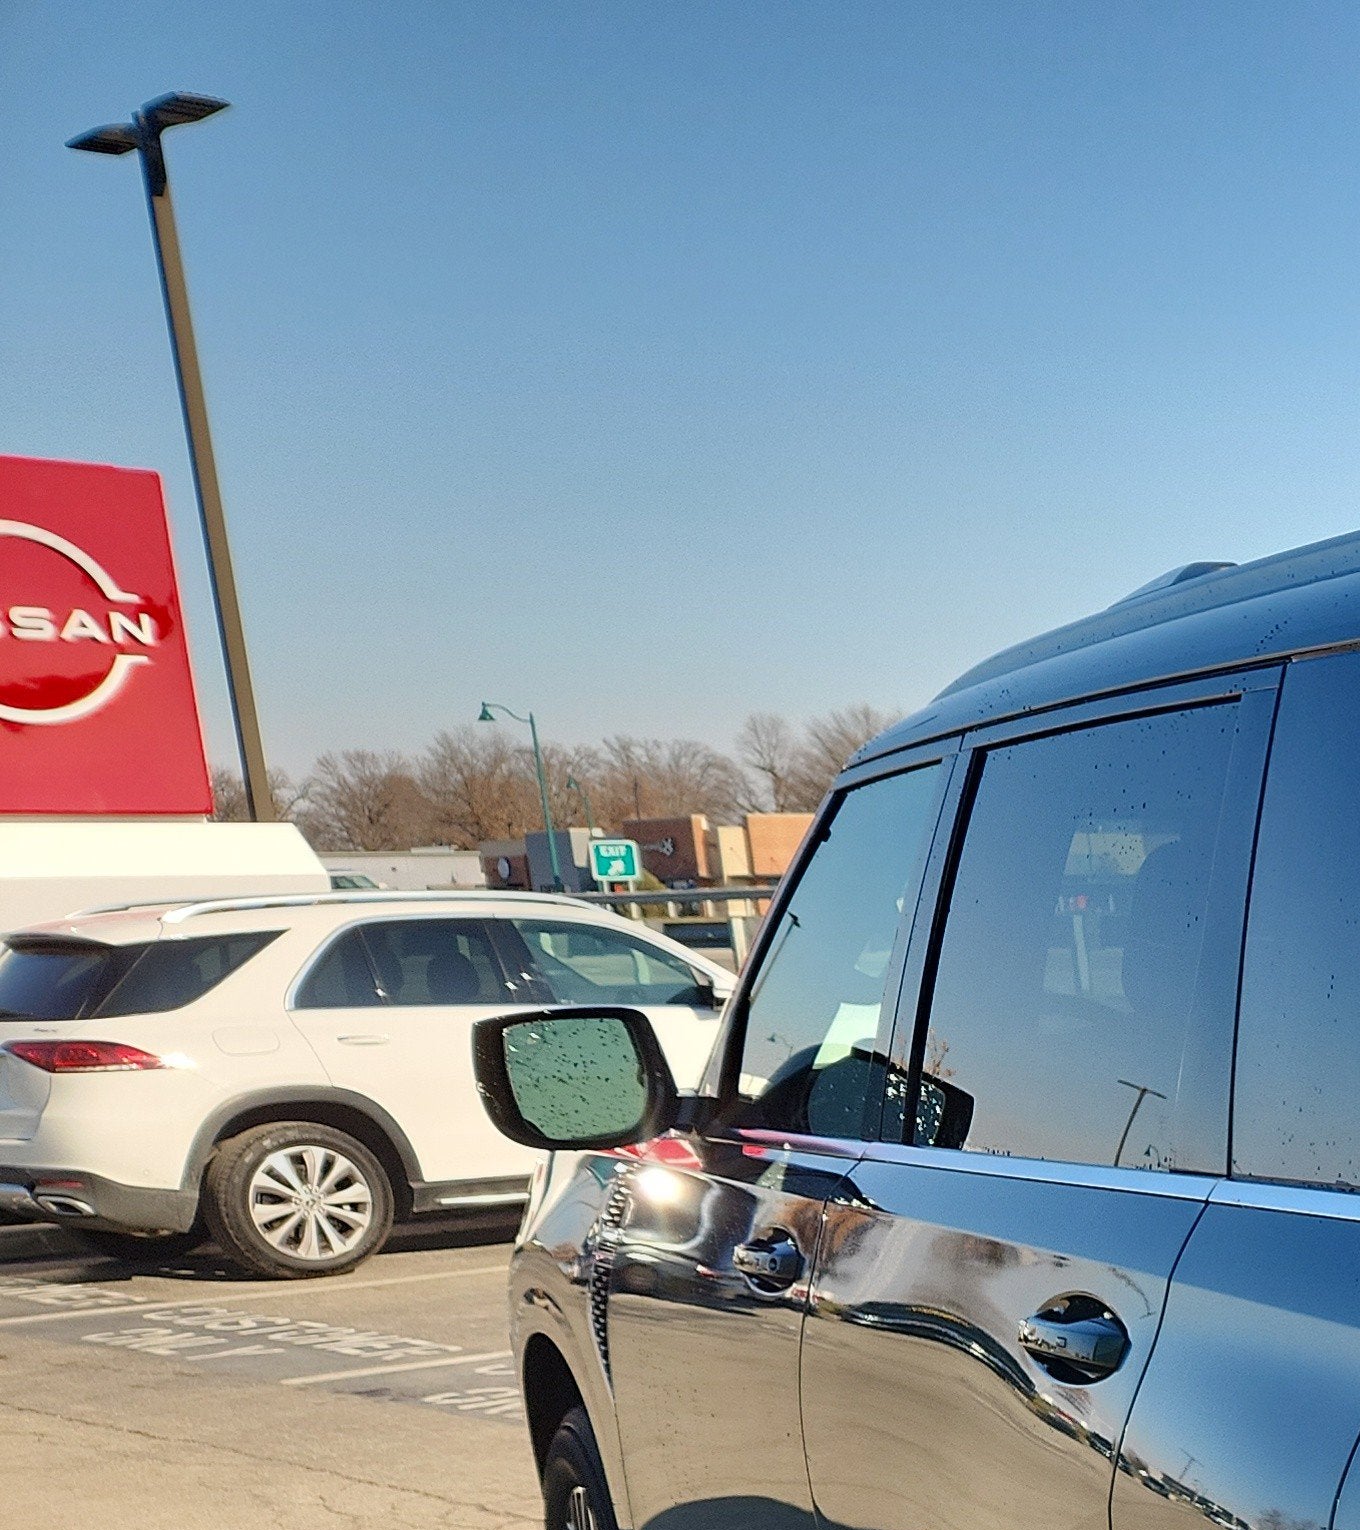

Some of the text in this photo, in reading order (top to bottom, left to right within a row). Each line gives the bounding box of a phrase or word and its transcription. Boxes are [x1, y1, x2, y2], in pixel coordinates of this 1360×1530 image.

[0, 606, 158, 647] SAN
[599, 845, 627, 857] EXIT
[81, 1327, 287, 1361] ONLY
[142, 1307, 464, 1361] CUSTOMER
